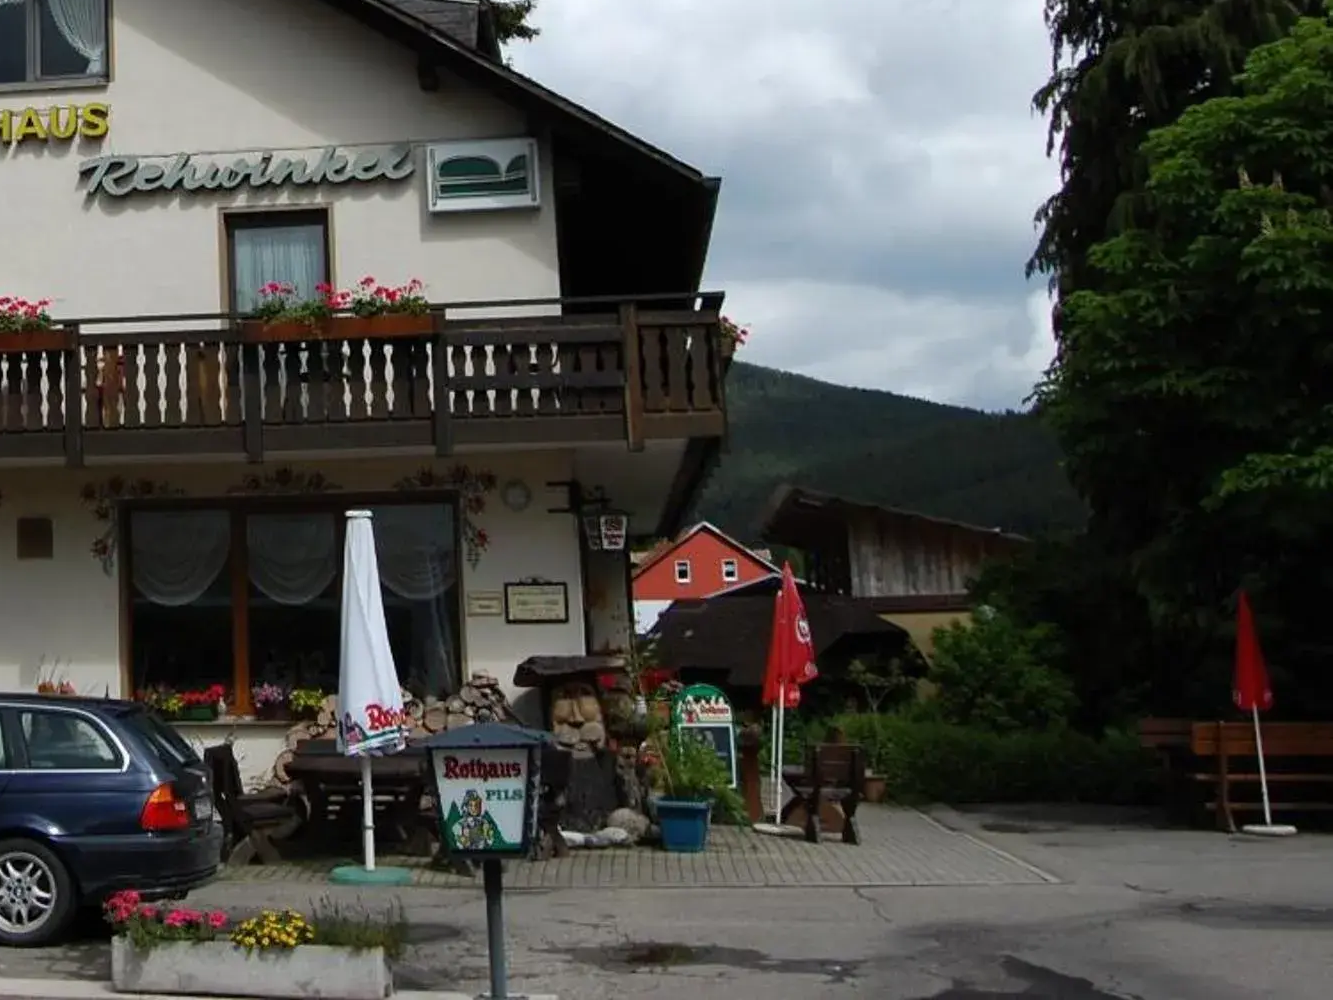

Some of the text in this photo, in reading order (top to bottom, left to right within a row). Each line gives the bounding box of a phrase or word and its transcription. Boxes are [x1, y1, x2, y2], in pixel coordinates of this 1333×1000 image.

[78, 142, 415, 197] Rehwinkel
[443, 755, 522, 781] Rothaus
[485, 788, 524, 801] PILS
